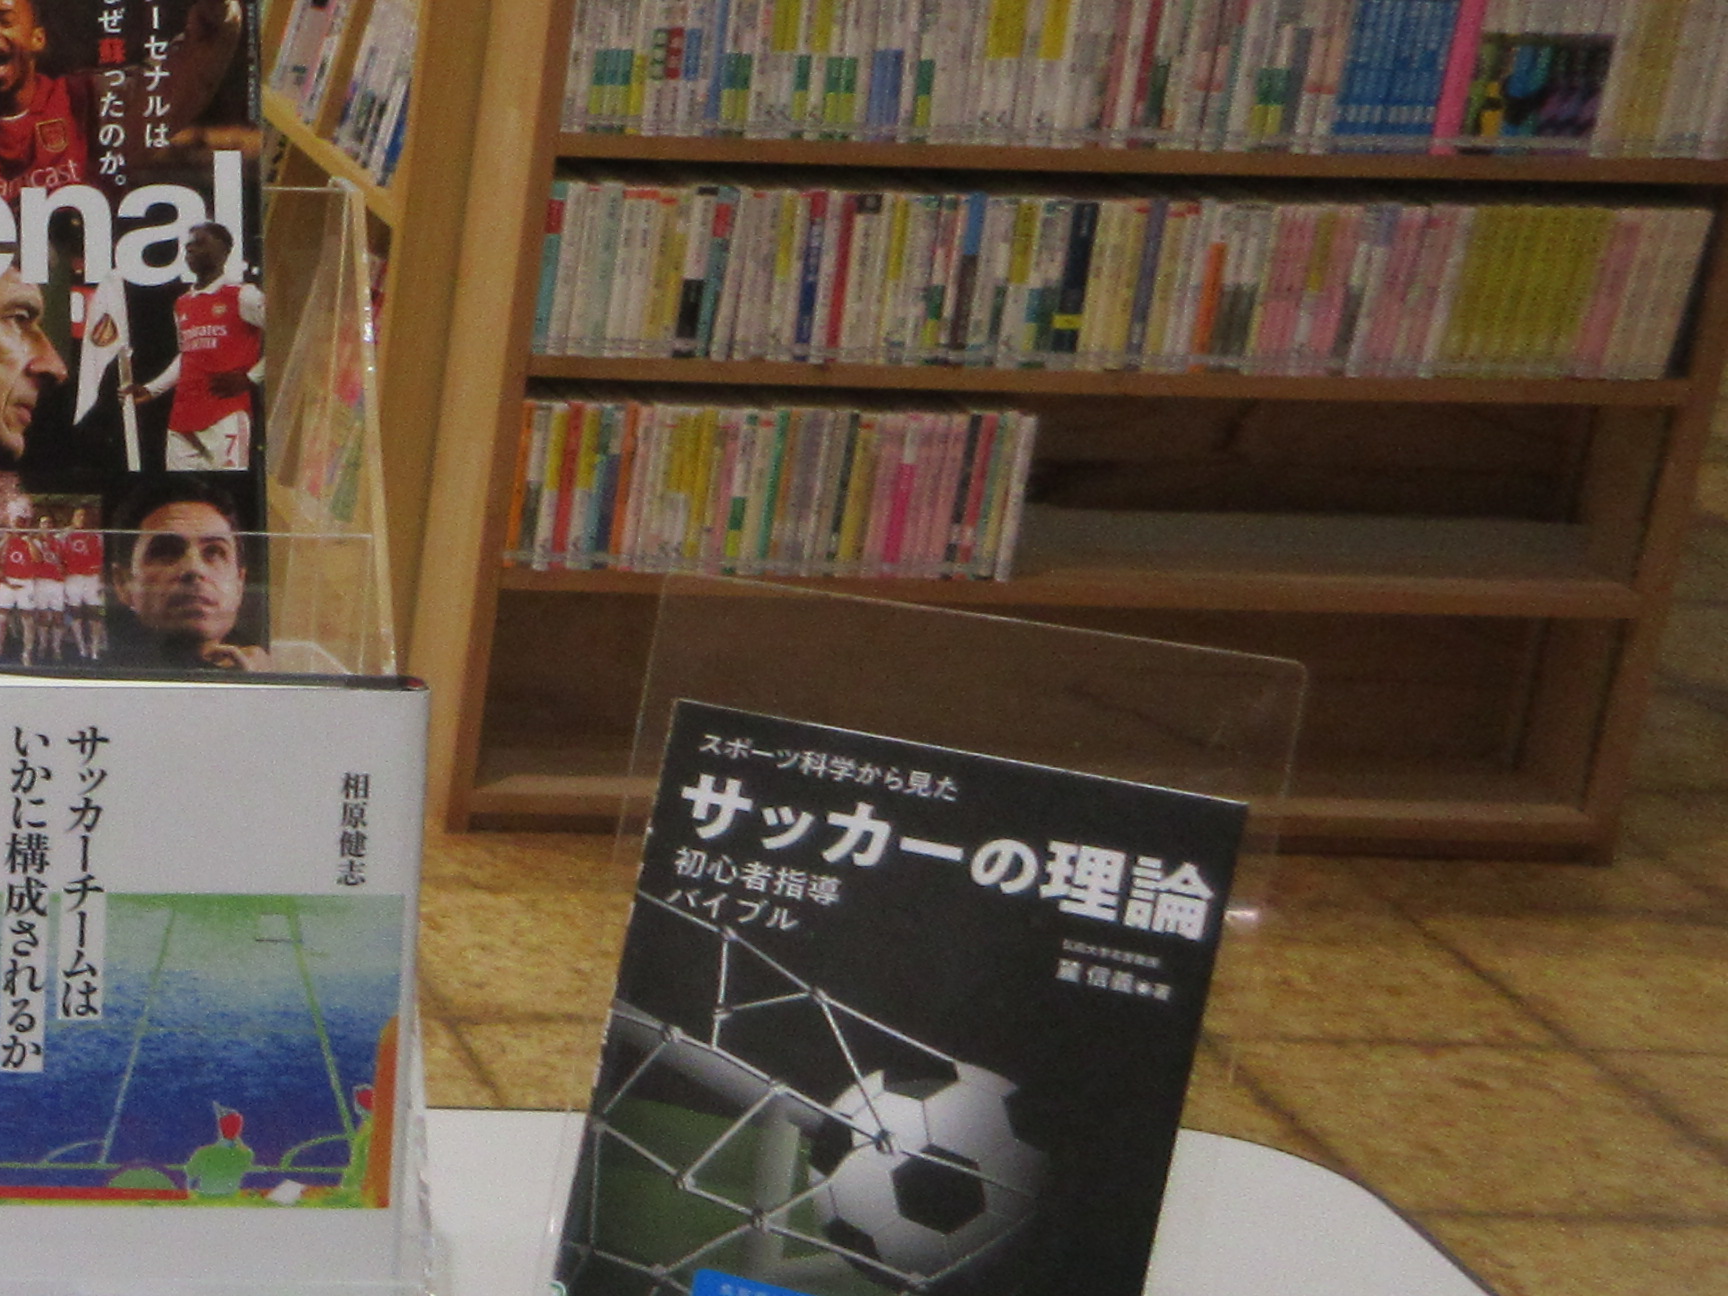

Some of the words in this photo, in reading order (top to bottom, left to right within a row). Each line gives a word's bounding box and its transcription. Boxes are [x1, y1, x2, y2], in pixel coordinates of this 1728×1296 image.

[336, 772, 371, 886] 相原健志
[699, 733, 959, 801] スポーツ科学から見た
[0, 726, 52, 1070] いかに構成されるか
[60, 726, 111, 1018] サッカーチームは
[673, 846, 842, 904] 初心者指導
[679, 772, 1215, 942] サッカーの理論
